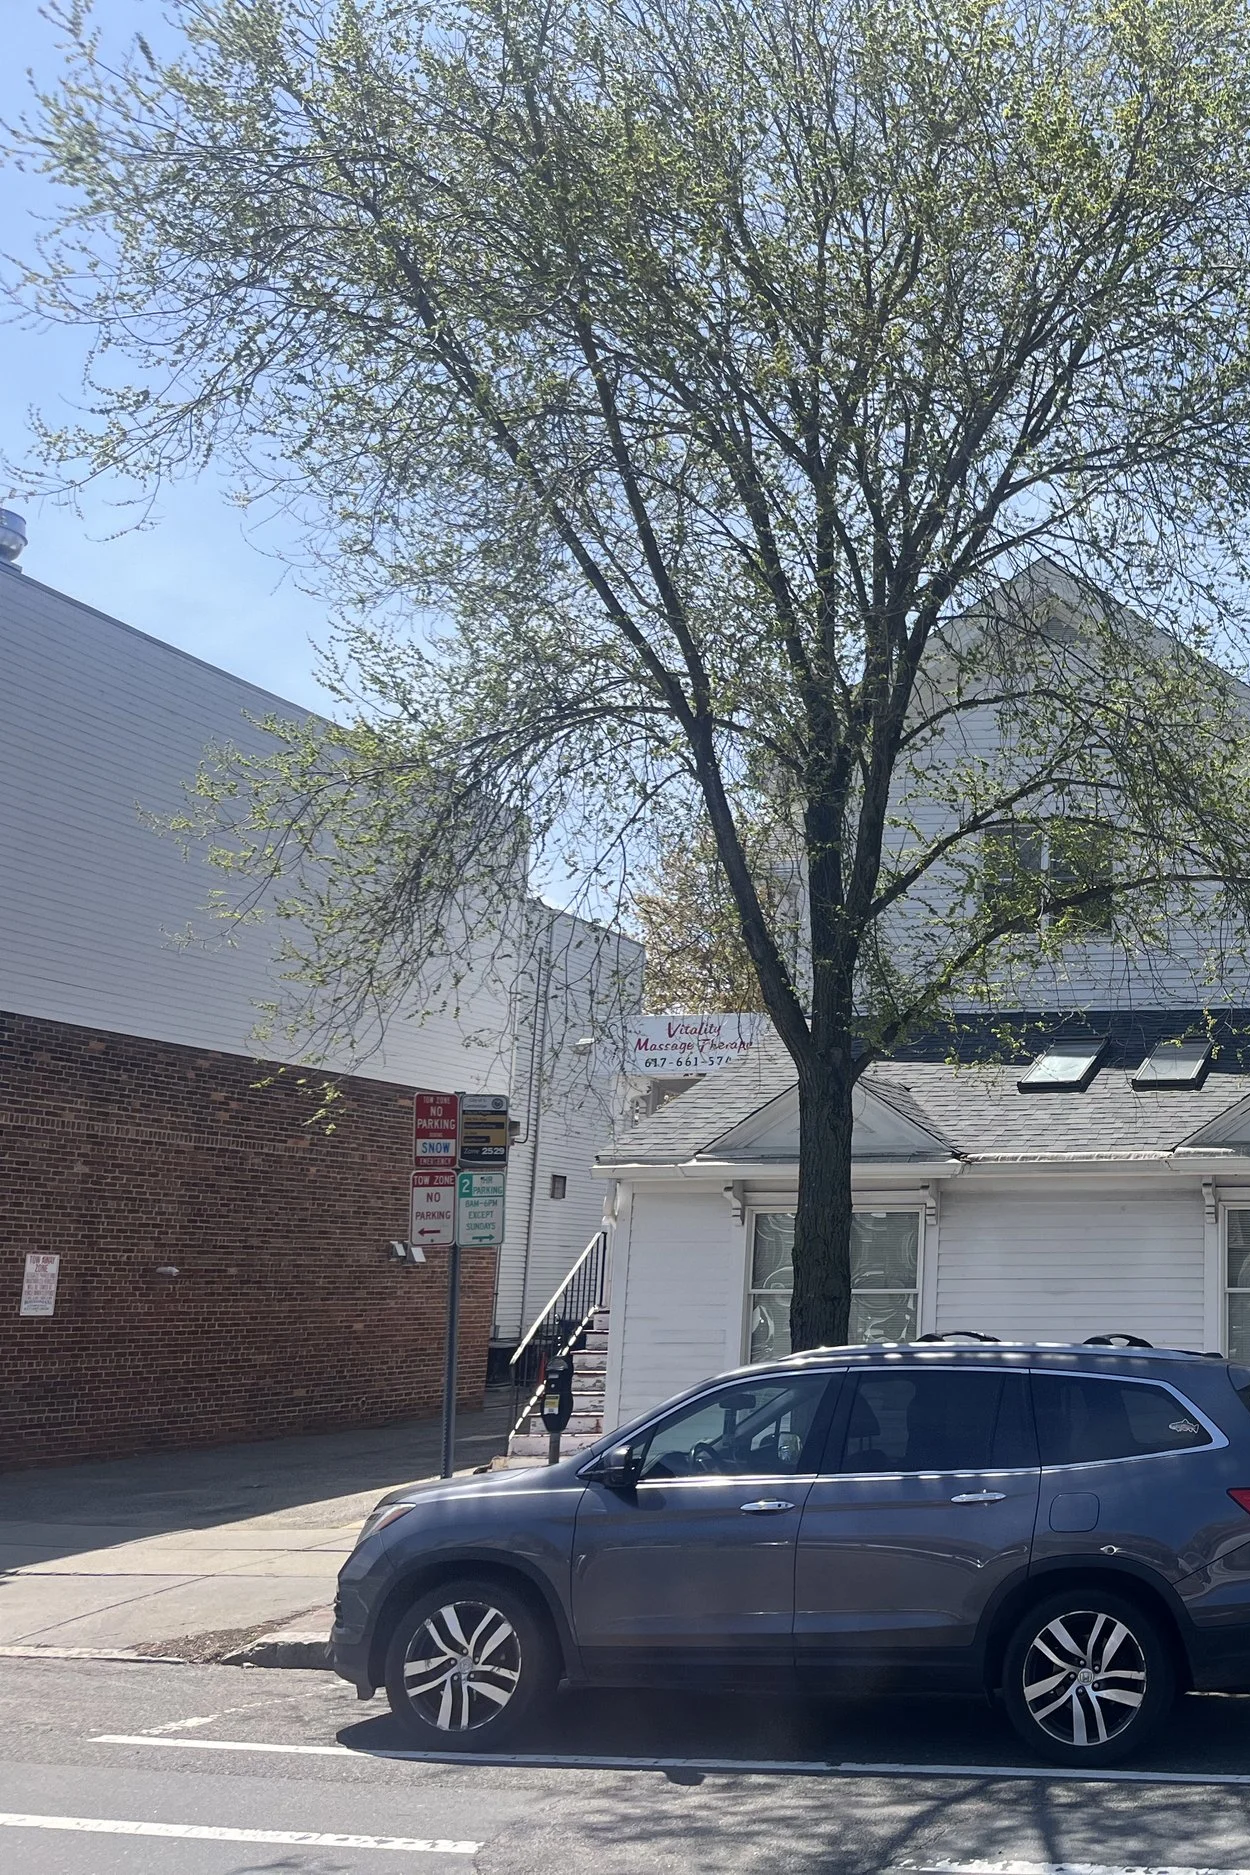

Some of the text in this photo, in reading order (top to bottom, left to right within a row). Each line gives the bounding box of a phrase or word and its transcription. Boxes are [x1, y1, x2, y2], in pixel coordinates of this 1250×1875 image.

[667, 1022, 721, 1038] Vitality
[634, 1038, 694, 1054] Massage
[423, 1096, 451, 1104] TOW ZONE
[430, 1106, 443, 1117] NO
[417, 1118, 456, 1130] PARKING
[421, 1142, 450, 1154] SNOW
[481, 1147, 505, 1155] 2529
[413, 1175, 455, 1185] TOW ZONE
[462, 1179, 470, 1193] 2
[473, 1186, 503, 1195] PARKING
[426, 1192, 441, 1203] NO
[465, 1199, 498, 1208] 8AM-6PM
[415, 1210, 451, 1220] PARKING
[468, 1210, 494, 1219] EXCEPT
[465, 1222, 496, 1230] SUNDAYS
